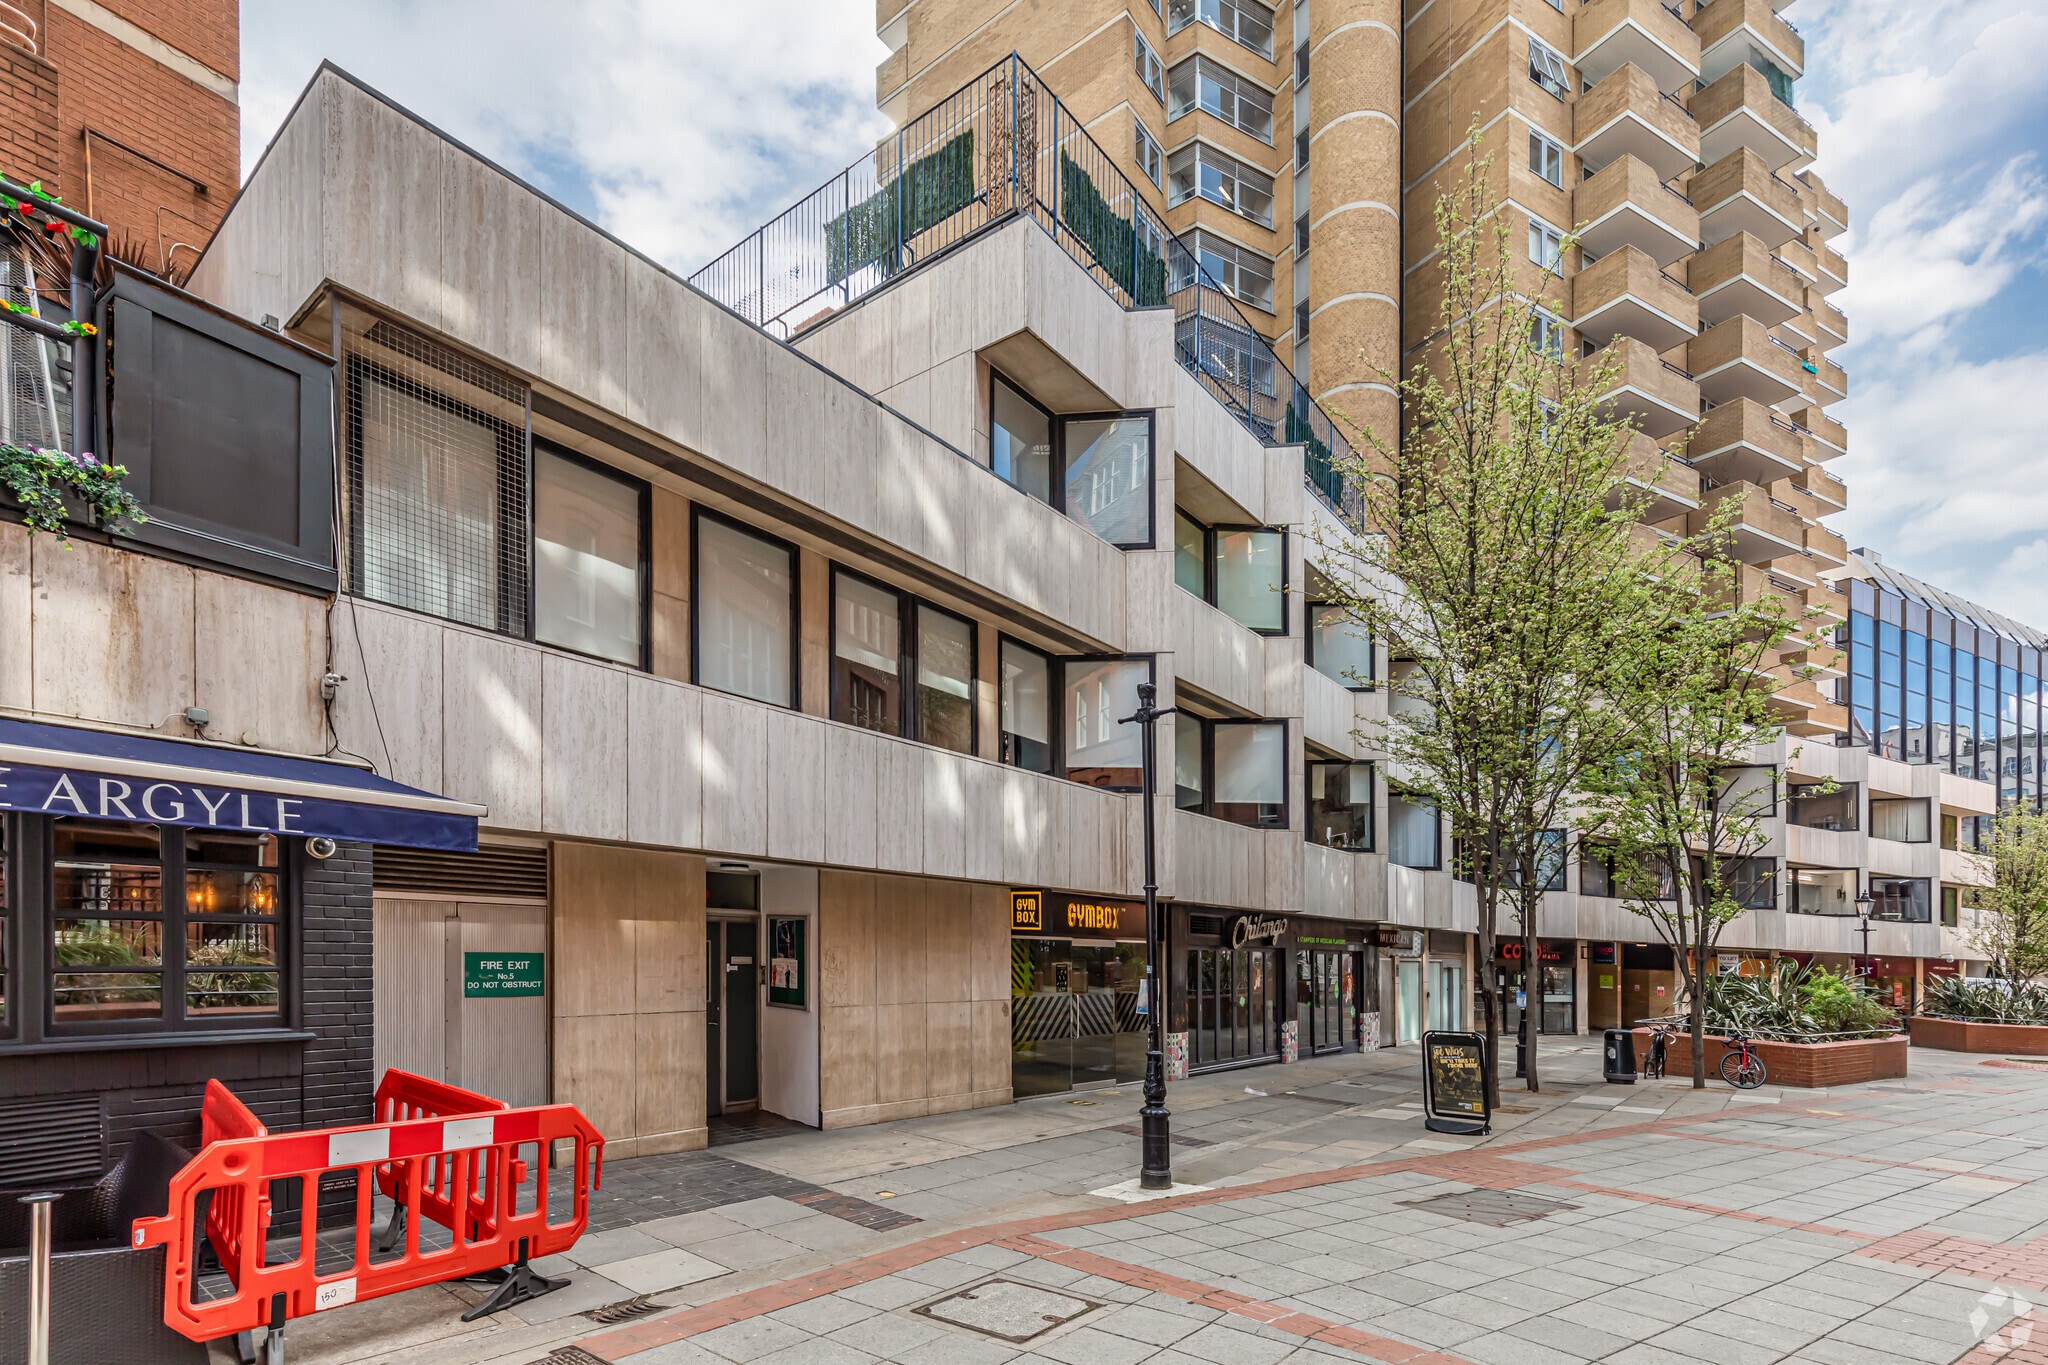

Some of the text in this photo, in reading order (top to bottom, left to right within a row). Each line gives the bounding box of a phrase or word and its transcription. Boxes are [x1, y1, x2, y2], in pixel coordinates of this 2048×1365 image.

[42, 773, 304, 834] ARGYLE
[1016, 898, 1036, 910] GYM
[1016, 911, 1036, 923] BOX
[1067, 903, 1119, 929] GYMBOX
[1232, 913, 1288, 950] Chilango
[1379, 933, 1410, 944] MEXICAN
[481, 961, 530, 969] FIRE EXIT
[321, 1288, 337, 1303] 150
